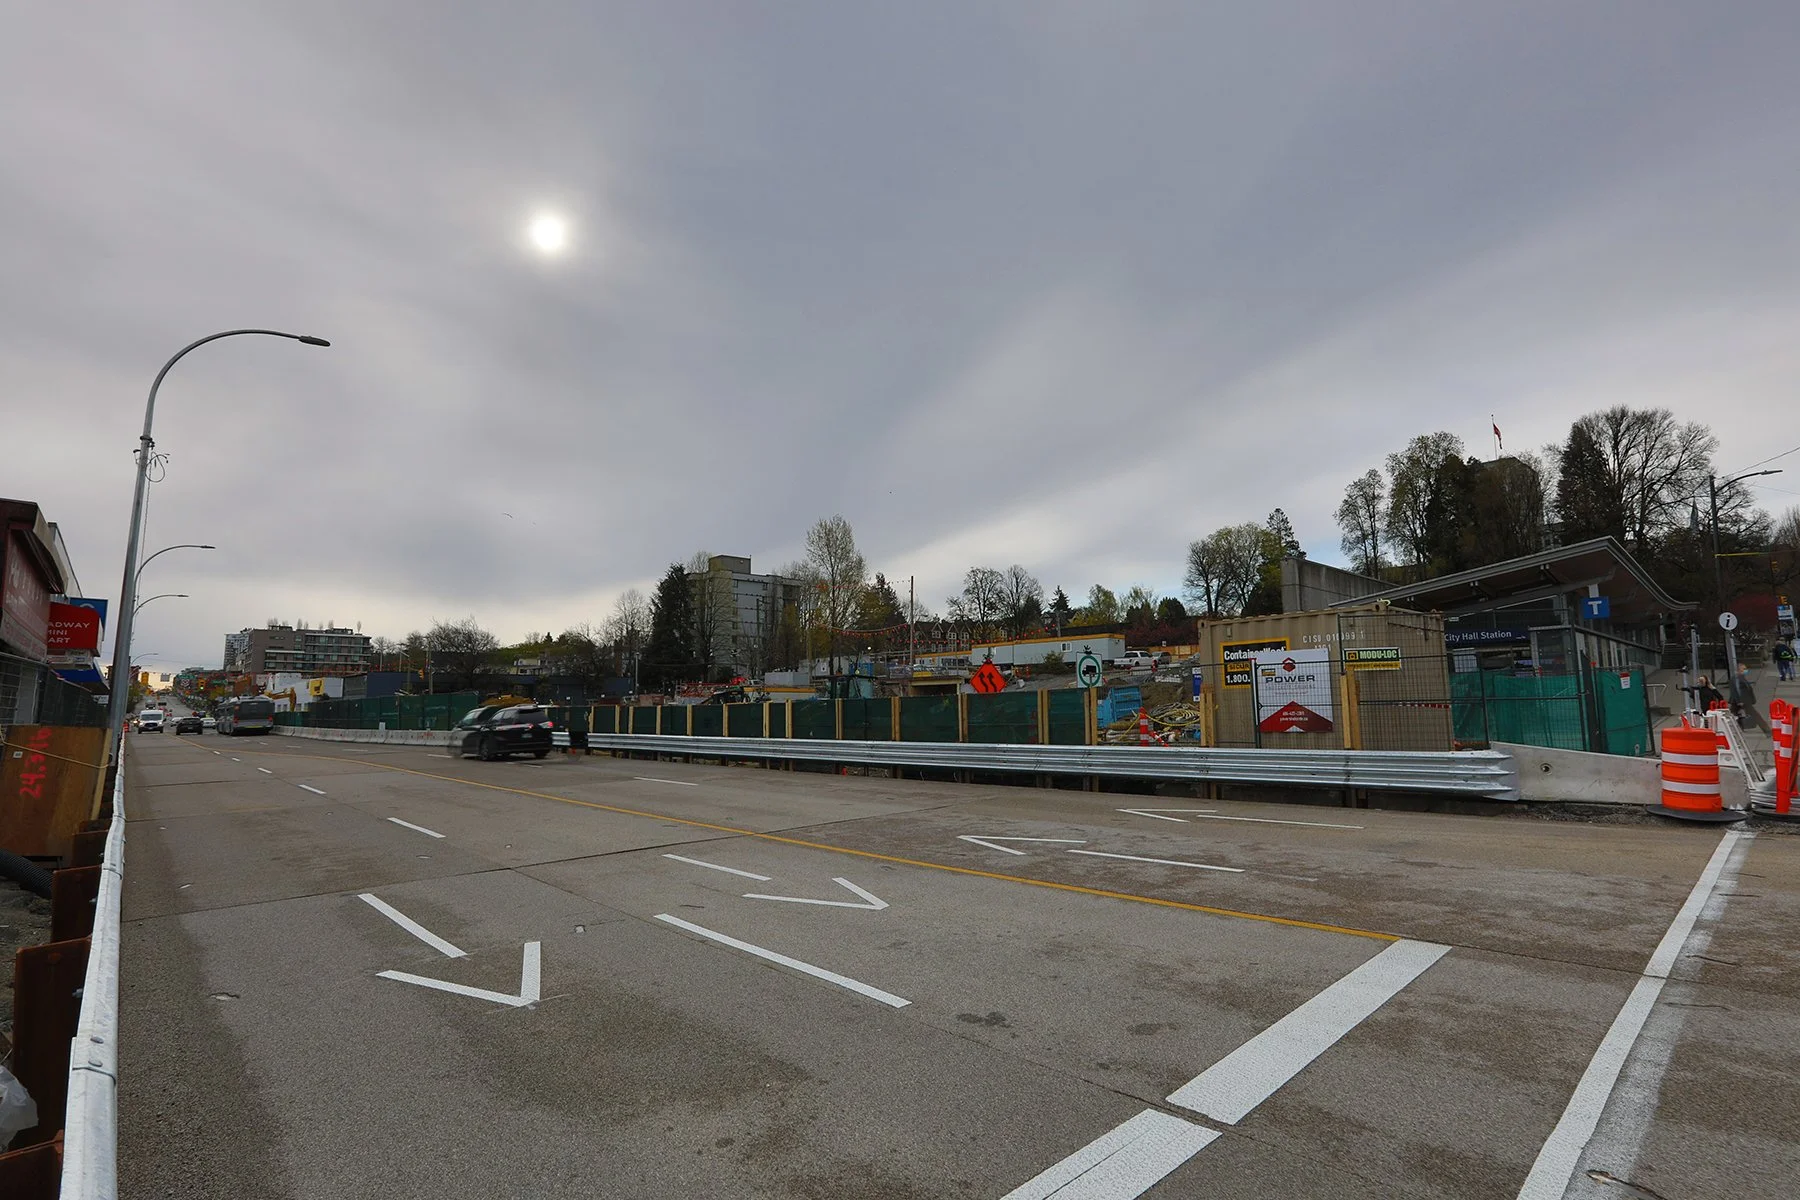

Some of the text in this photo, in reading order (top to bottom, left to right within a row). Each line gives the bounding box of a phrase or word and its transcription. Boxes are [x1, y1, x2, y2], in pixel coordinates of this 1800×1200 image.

[1587, 600, 1602, 615] T
[1444, 630, 1512, 643] City Hall Station
[1224, 646, 1285, 661] ContaiWt
[1359, 650, 1397, 660] MODU-LOC
[1265, 674, 1316, 684] POWER
